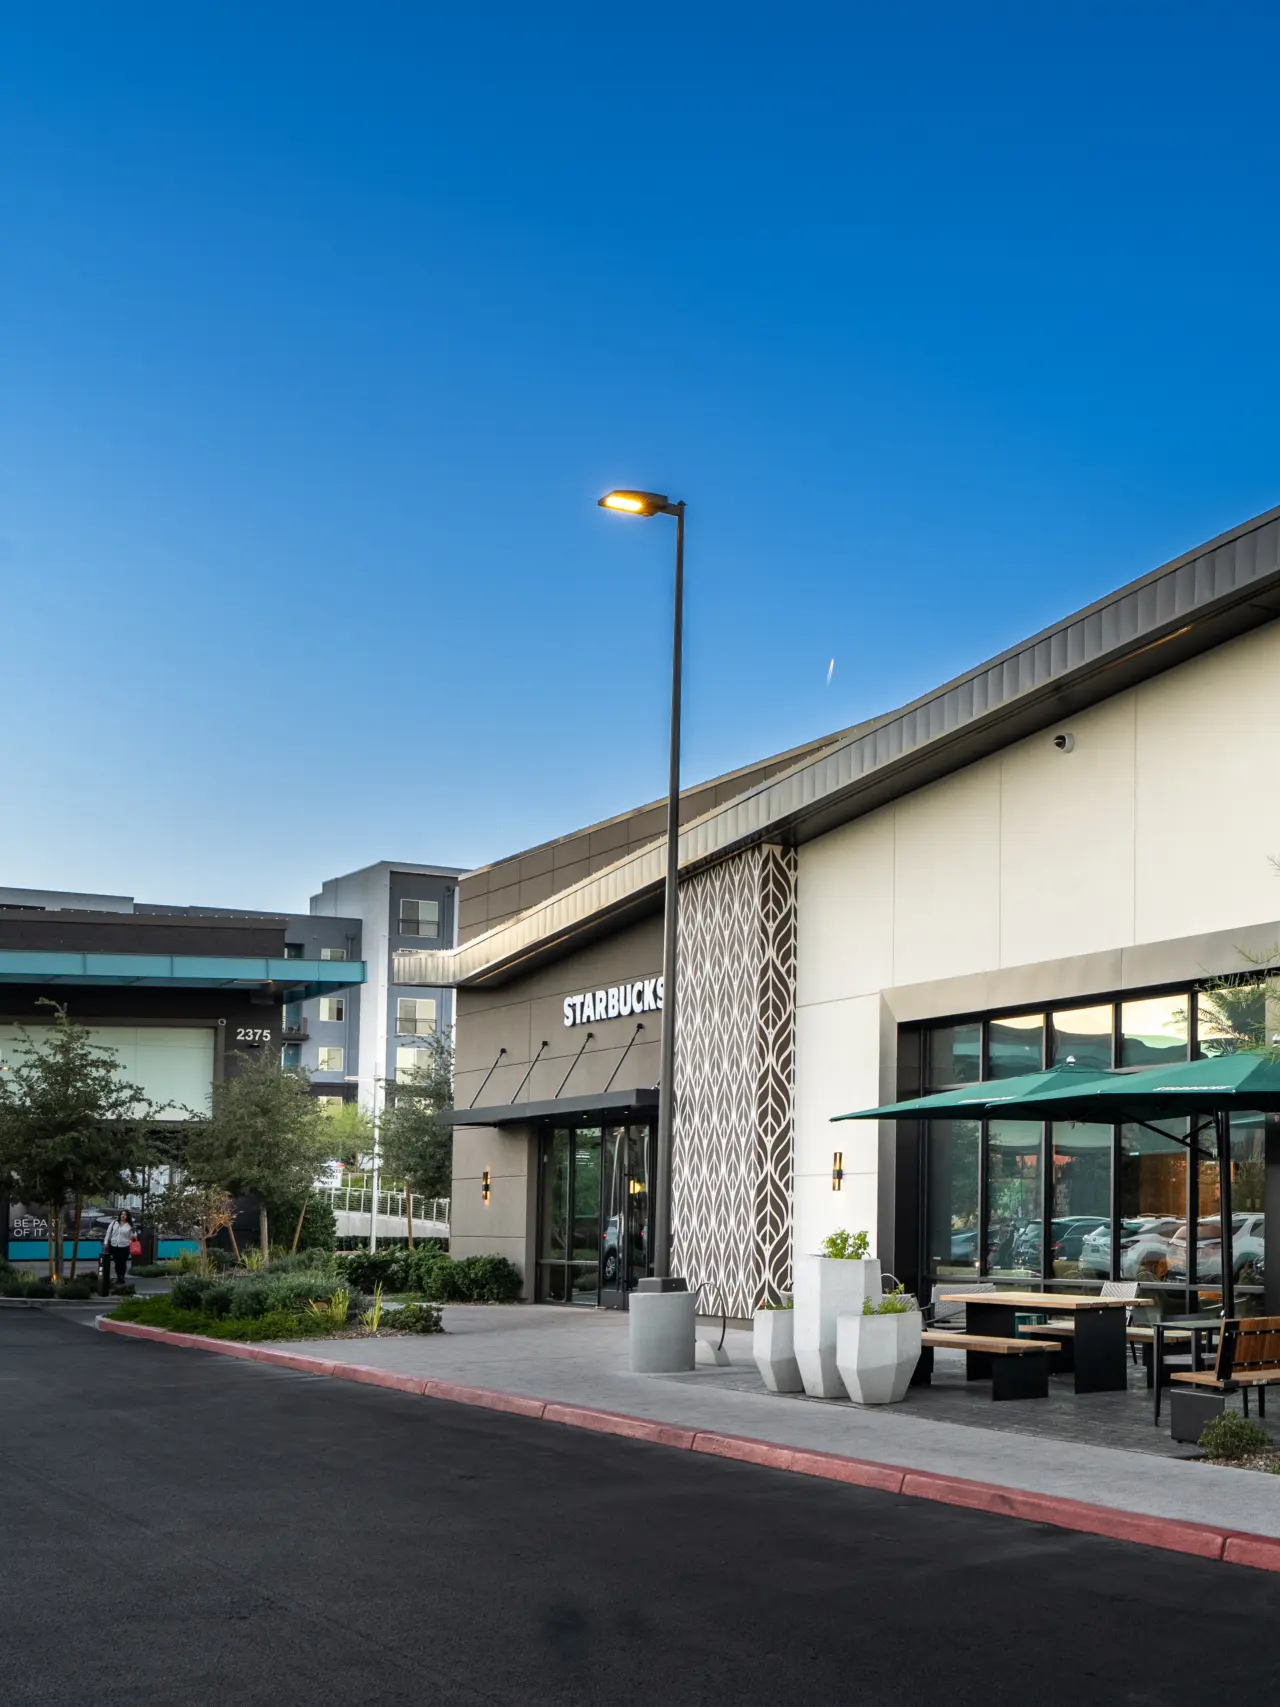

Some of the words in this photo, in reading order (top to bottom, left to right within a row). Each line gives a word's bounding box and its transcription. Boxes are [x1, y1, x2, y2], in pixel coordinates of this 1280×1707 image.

[563, 976, 664, 1027] STARBUCKS
[236, 1028, 271, 1041] 2375
[13, 1218, 29, 1228] BE
[13, 1228, 30, 1237] OF
[34, 1228, 44, 1237] IT
